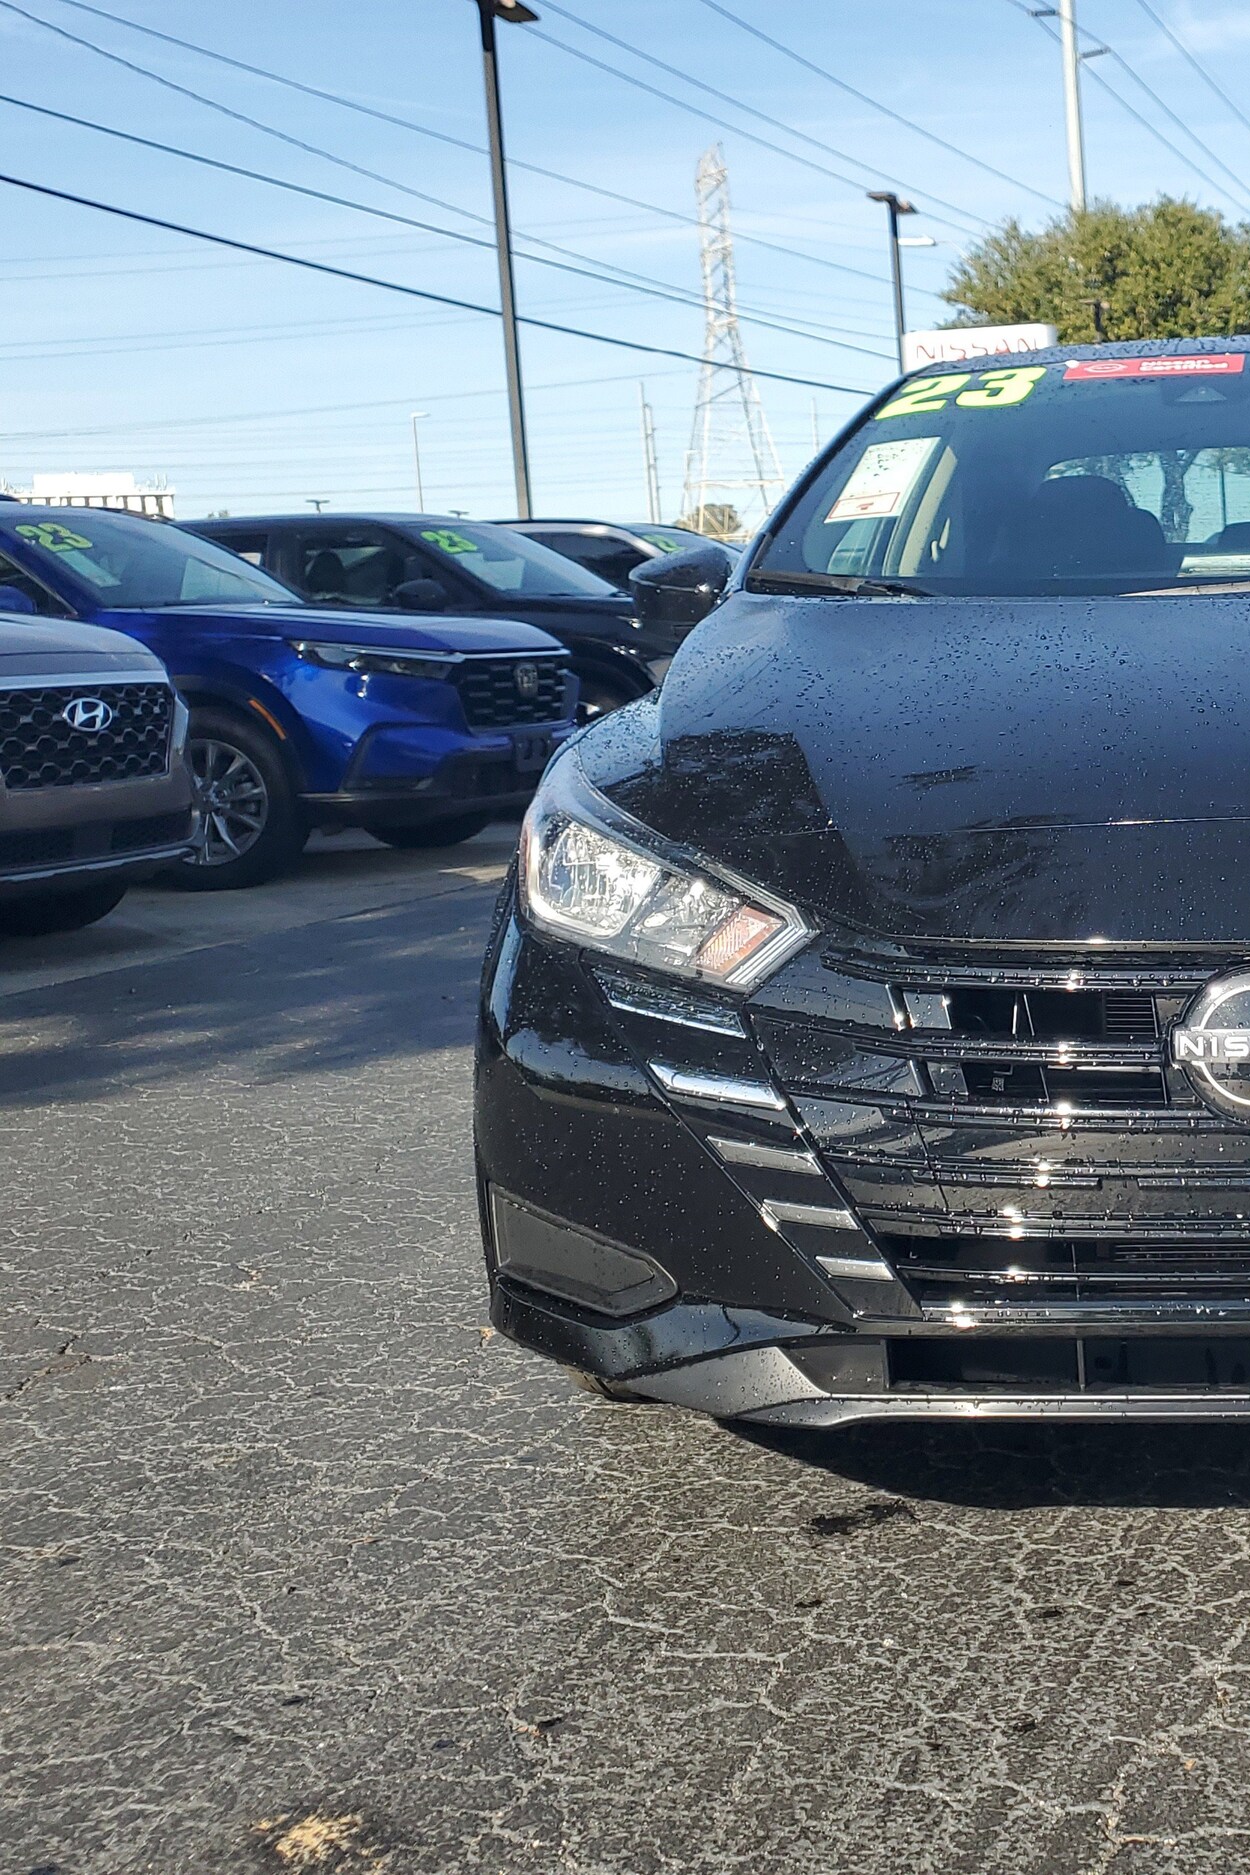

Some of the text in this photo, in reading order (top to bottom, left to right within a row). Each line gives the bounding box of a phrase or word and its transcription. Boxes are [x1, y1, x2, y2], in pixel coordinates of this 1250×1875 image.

[916, 337, 1040, 361] NISSAN
[873, 366, 1048, 421] 23
[15, 522, 93, 552] 23
[421, 529, 478, 553] 23
